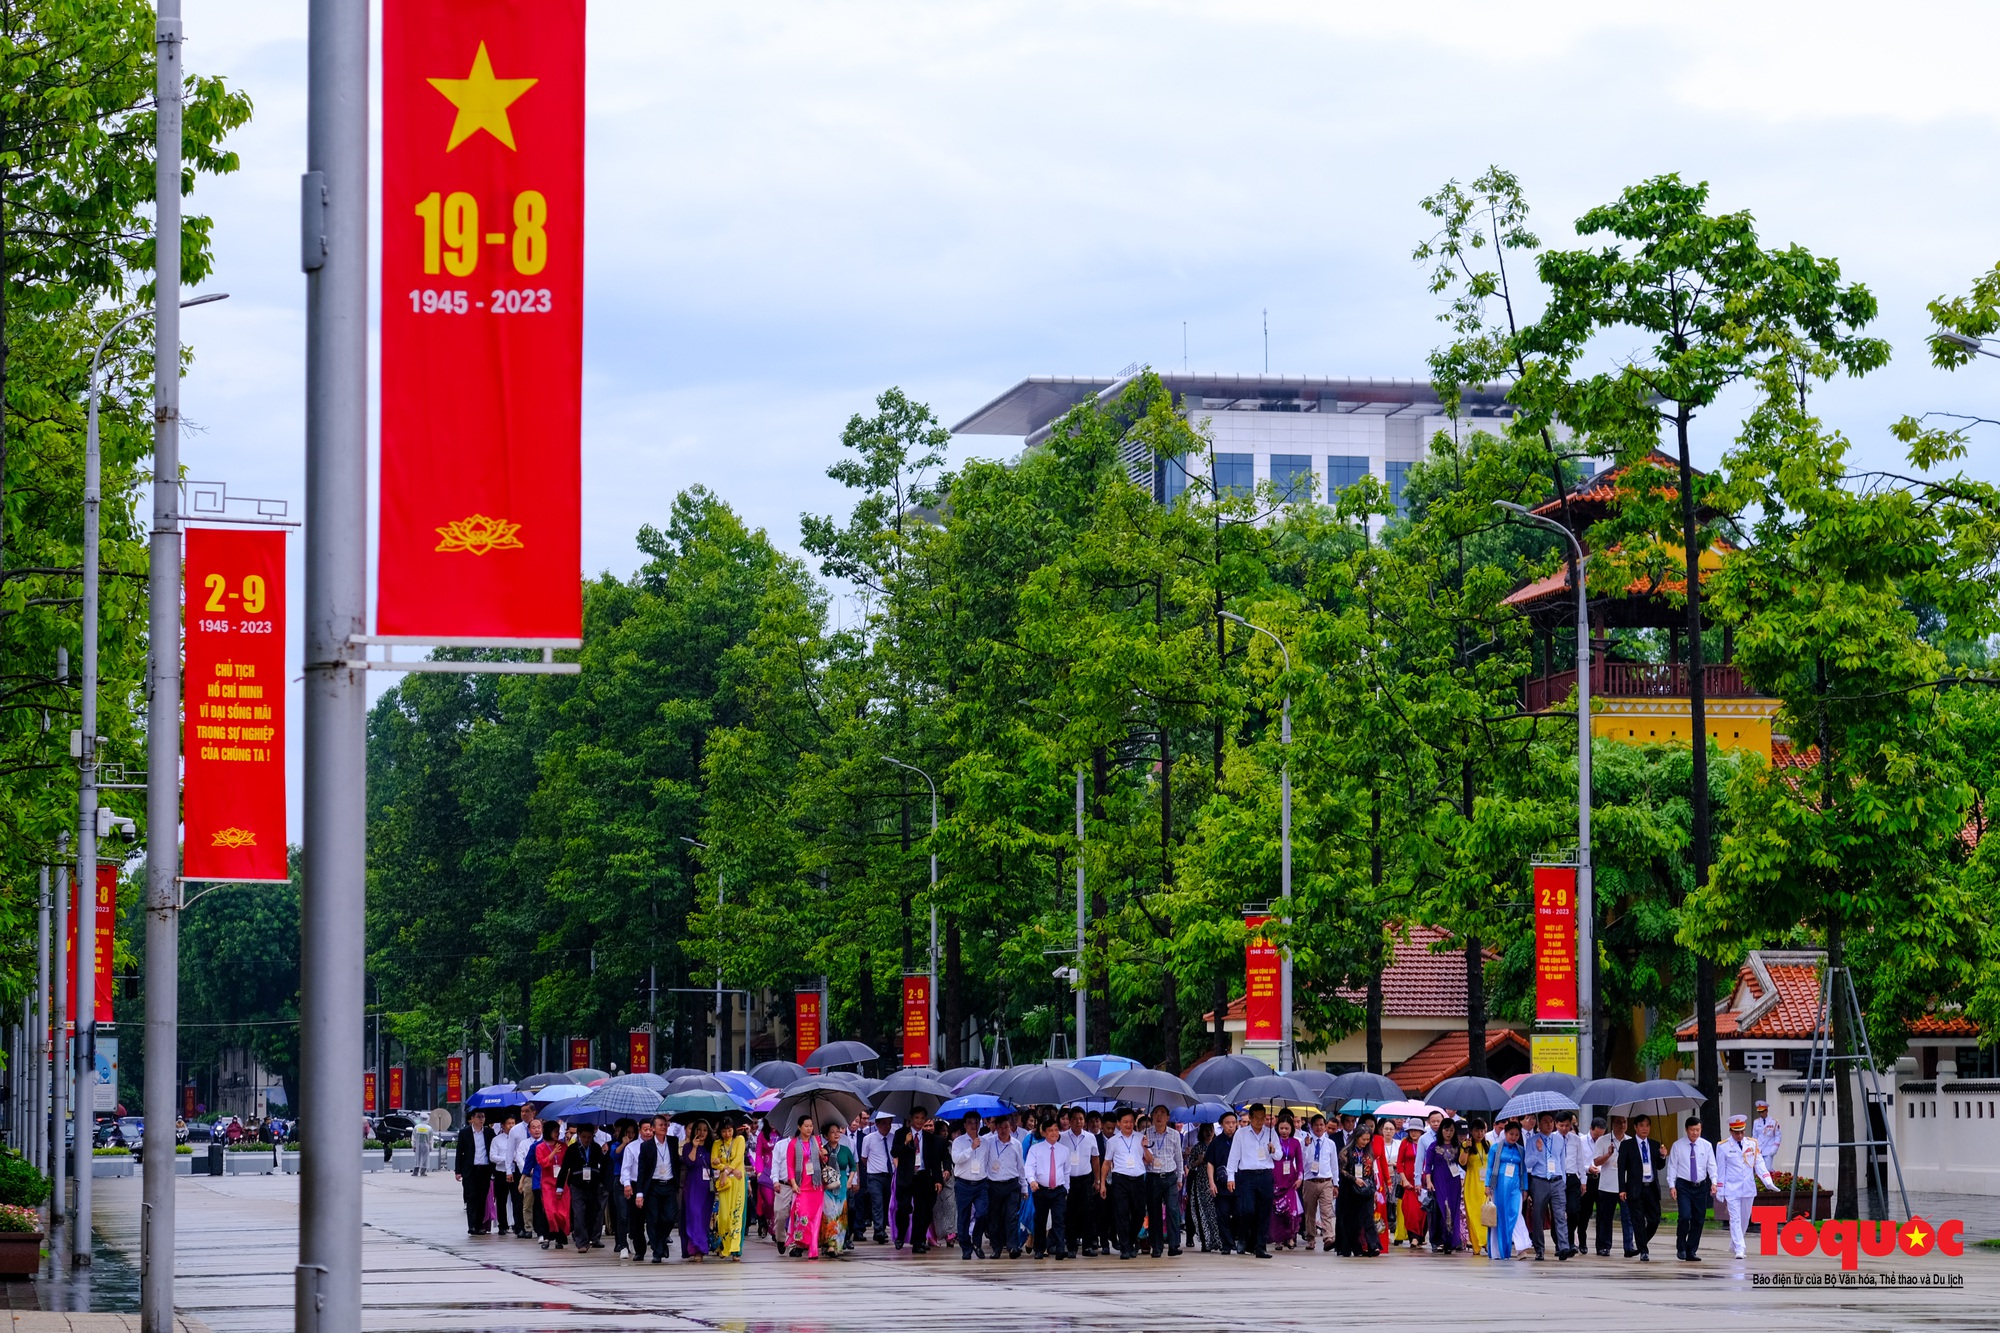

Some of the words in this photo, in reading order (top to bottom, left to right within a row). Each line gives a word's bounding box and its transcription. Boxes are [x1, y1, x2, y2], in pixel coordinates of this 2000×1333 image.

[414, 189, 548, 277] 19-8
[408, 289, 469, 315] 1945
[490, 288, 553, 314] 2023
[204, 573, 266, 614] 2-9
[198, 619, 229, 633] 1945
[240, 620, 272, 634] 2023
[215, 658, 233, 677] CHỦ
[234, 664, 255, 680] TỊCH
[207, 680, 220, 698] HỒ
[222, 682, 237, 698] CHÍ
[238, 685, 263, 699] MINH
[199, 702, 209, 718] VĨ
[210, 705, 226, 721] ĐẠI
[227, 702, 252, 720] SỐNG
[253, 704, 272, 720] MÃI
[196, 725, 226, 740] TRONG
[227, 726, 241, 743] SỰ
[241, 725, 275, 744] NGHIỆP
[200, 741, 220, 760] CỦA
[221, 745, 252, 761] CHÚNG
[253, 748, 265, 762] TA
